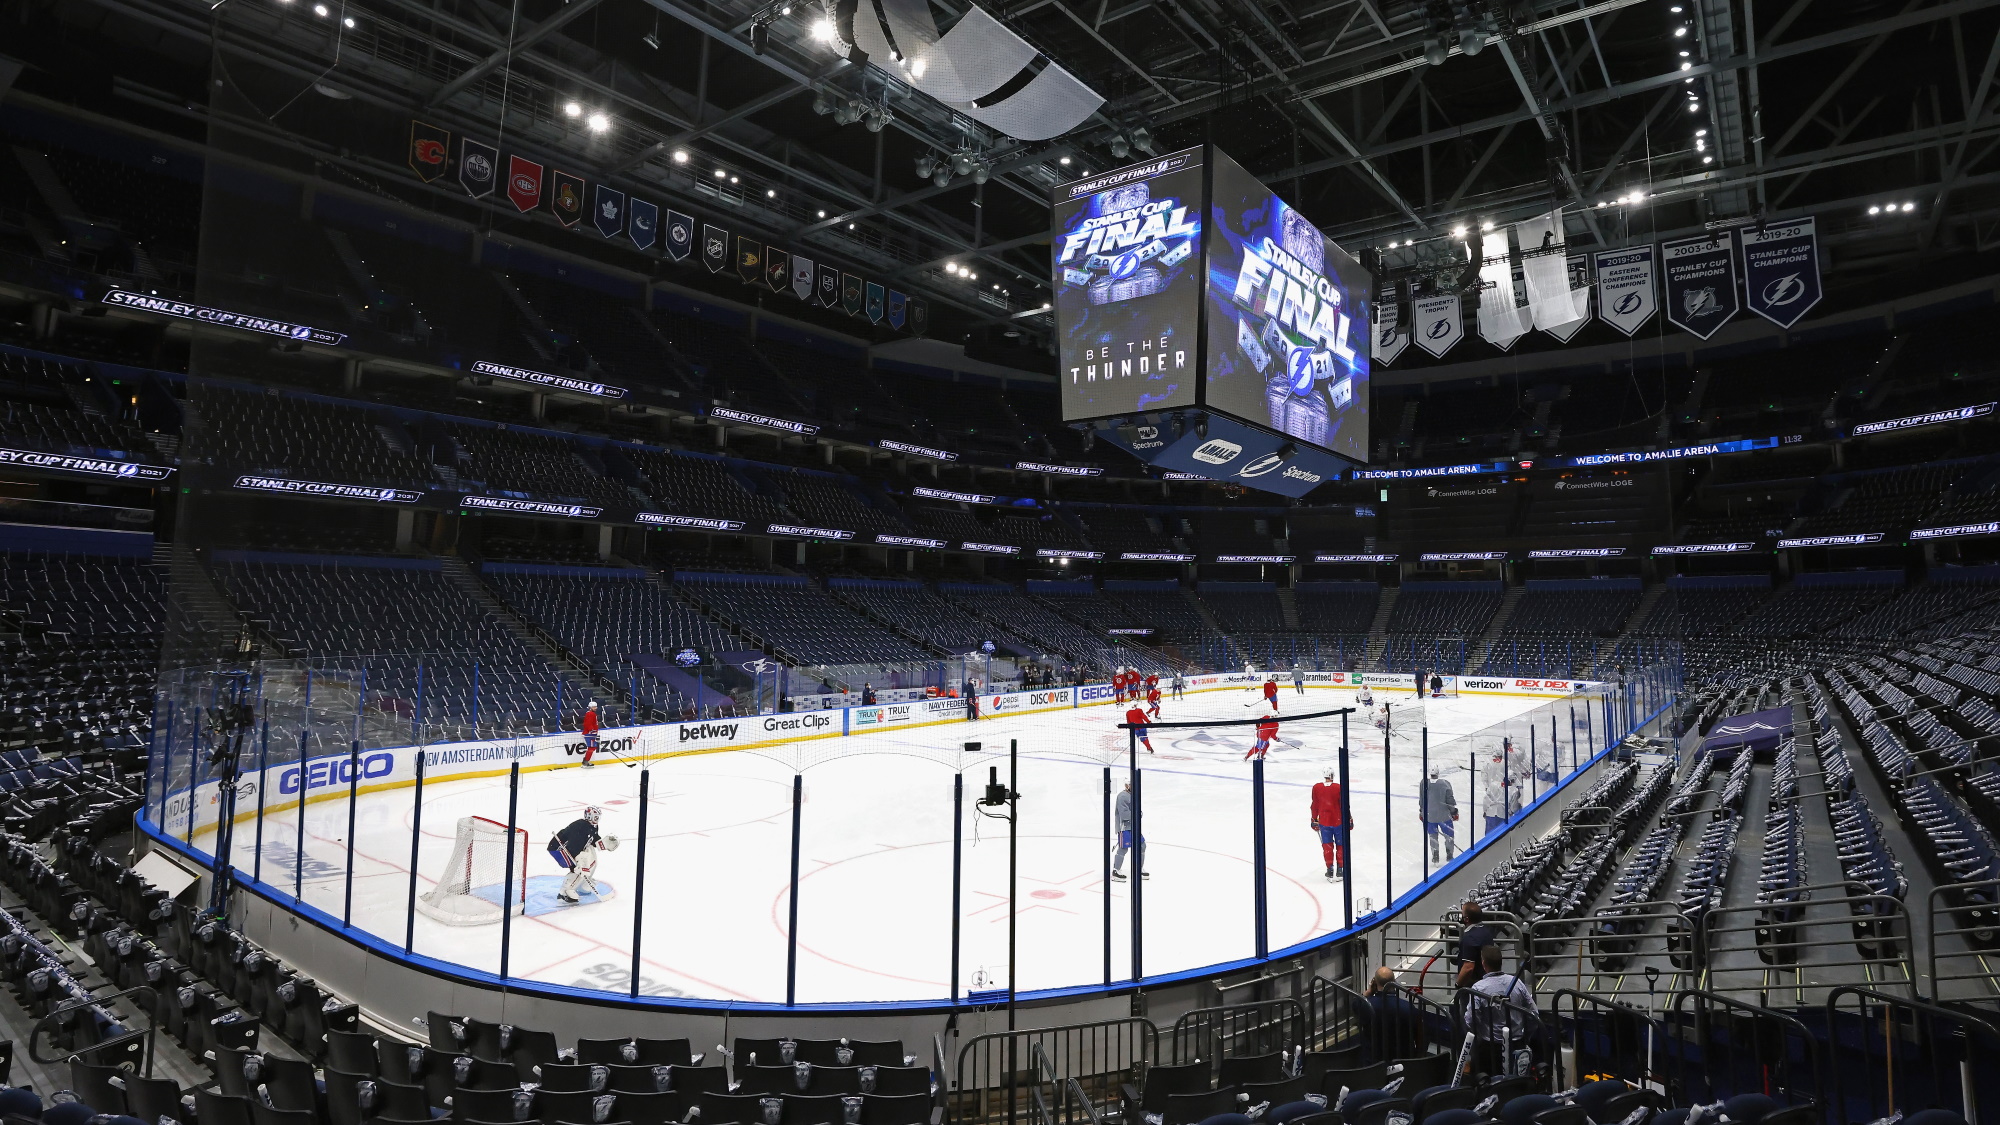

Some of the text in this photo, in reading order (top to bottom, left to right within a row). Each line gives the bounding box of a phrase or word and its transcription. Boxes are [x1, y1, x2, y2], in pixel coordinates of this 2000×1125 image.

[1072, 178, 1108, 194] STANLEY
[1108, 174, 1126, 184] CUP
[1128, 166, 1157, 179] FINAL
[1083, 200, 1173, 228] STANLEY CUP
[1059, 206, 1196, 264] FINAL
[1750, 244, 1810, 260] STANLEY CUP
[1606, 254, 1641, 266] 2019-20
[1670, 258, 1728, 274] STANLEY CUP
[1754, 254, 1808, 268] CHAMPIONS
[1262, 236, 1341, 306] STANLEY CUP
[1602, 272, 1648, 284] CONFERENCE
[1609, 266, 1640, 276] EASTERN
[1674, 268, 1726, 282] CHAMPIONS
[1605, 280, 1646, 290] CHAMPIONS
[1232, 244, 1356, 362] FINAL
[1418, 298, 1455, 309] PRESIDENTS'
[1424, 306, 1449, 314] TROPHY
[111, 292, 334, 341] STANLEY CUP FINAL 2021
[1086, 336, 1168, 360] BE THE
[1070, 350, 1185, 384] THUNDER
[1316, 359, 1328, 374] 21
[476, 362, 530, 379] STANLEY
[530, 373, 554, 383] CUP
[554, 378, 590, 391] FINAL
[714, 408, 752, 420] STANLEY
[768, 419, 794, 430] FINAL
[1856, 410, 1960, 434] STANLEY CUP FINAL
[1784, 434, 1802, 444] 11:32
[908, 445, 922, 454] CUP
[920, 448, 940, 458] FINAL
[1198, 444, 1238, 460] AMALIE
[1576, 445, 1718, 465] WELCOME TO AMALIE ARENA
[23, 454, 62, 466] CUP
[62, 458, 118, 474] FINAL
[1018, 462, 1046, 471] STANLEY
[1058, 466, 1080, 474] FINAL
[1356, 465, 1477, 479] WELCOME TO AMALIE ARENA
[240, 478, 306, 490] STANLEY
[306, 484, 336, 493] CUP
[335, 487, 379, 498] FINAL
[1566, 480, 1633, 490] ConnectWise LOGE
[916, 488, 941, 497] STANLEY
[952, 493, 972, 502] FINAL
[466, 498, 514, 508] STANLEY
[536, 504, 568, 514] FINAL
[638, 514, 676, 524] STANLEY
[693, 520, 719, 528] FINAL
[770, 526, 800, 534] STANLEY
[1912, 529, 1945, 538] STANLEY
[1962, 525, 1988, 534] FINAL
[1780, 538, 1812, 547] STANLEY
[1829, 536, 1856, 544] FINAL
[1464, 680, 1503, 689] verizon
[1030, 691, 1068, 706] DISCOVER
[1082, 686, 1115, 700] GEICO
[928, 700, 968, 710] NAVY FEDERA
[1002, 696, 1018, 706] pepsi
[859, 710, 878, 718] TRULY
[888, 706, 910, 715] TRULY
[764, 714, 830, 732] Great Clips
[679, 724, 738, 742] betway
[564, 736, 632, 756] veizon
[441, 748, 504, 764] AMSTERDAM
[279, 752, 394, 794] GEICO
